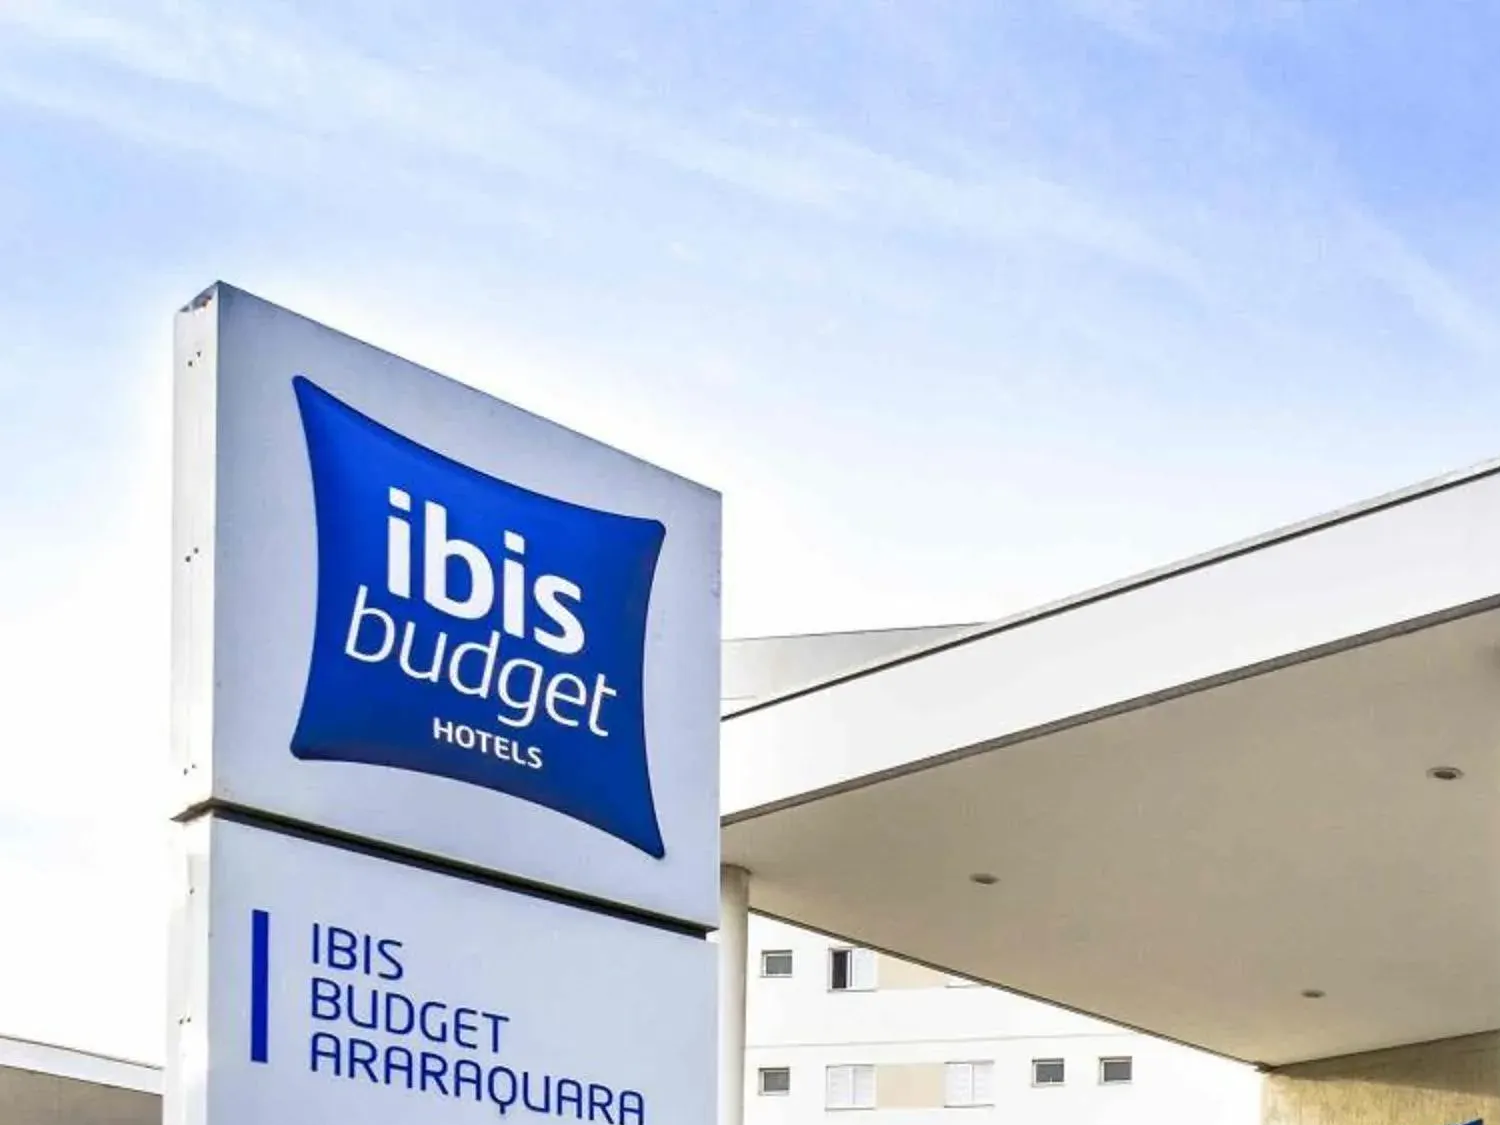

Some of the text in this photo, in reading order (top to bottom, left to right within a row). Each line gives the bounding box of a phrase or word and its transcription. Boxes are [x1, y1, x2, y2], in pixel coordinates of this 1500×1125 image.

[388, 486, 585, 655] ibis
[344, 584, 617, 737] budget
[433, 717, 543, 769] HOTELS
[312, 922, 404, 980] IBIS
[311, 977, 510, 1053] BUDGET
